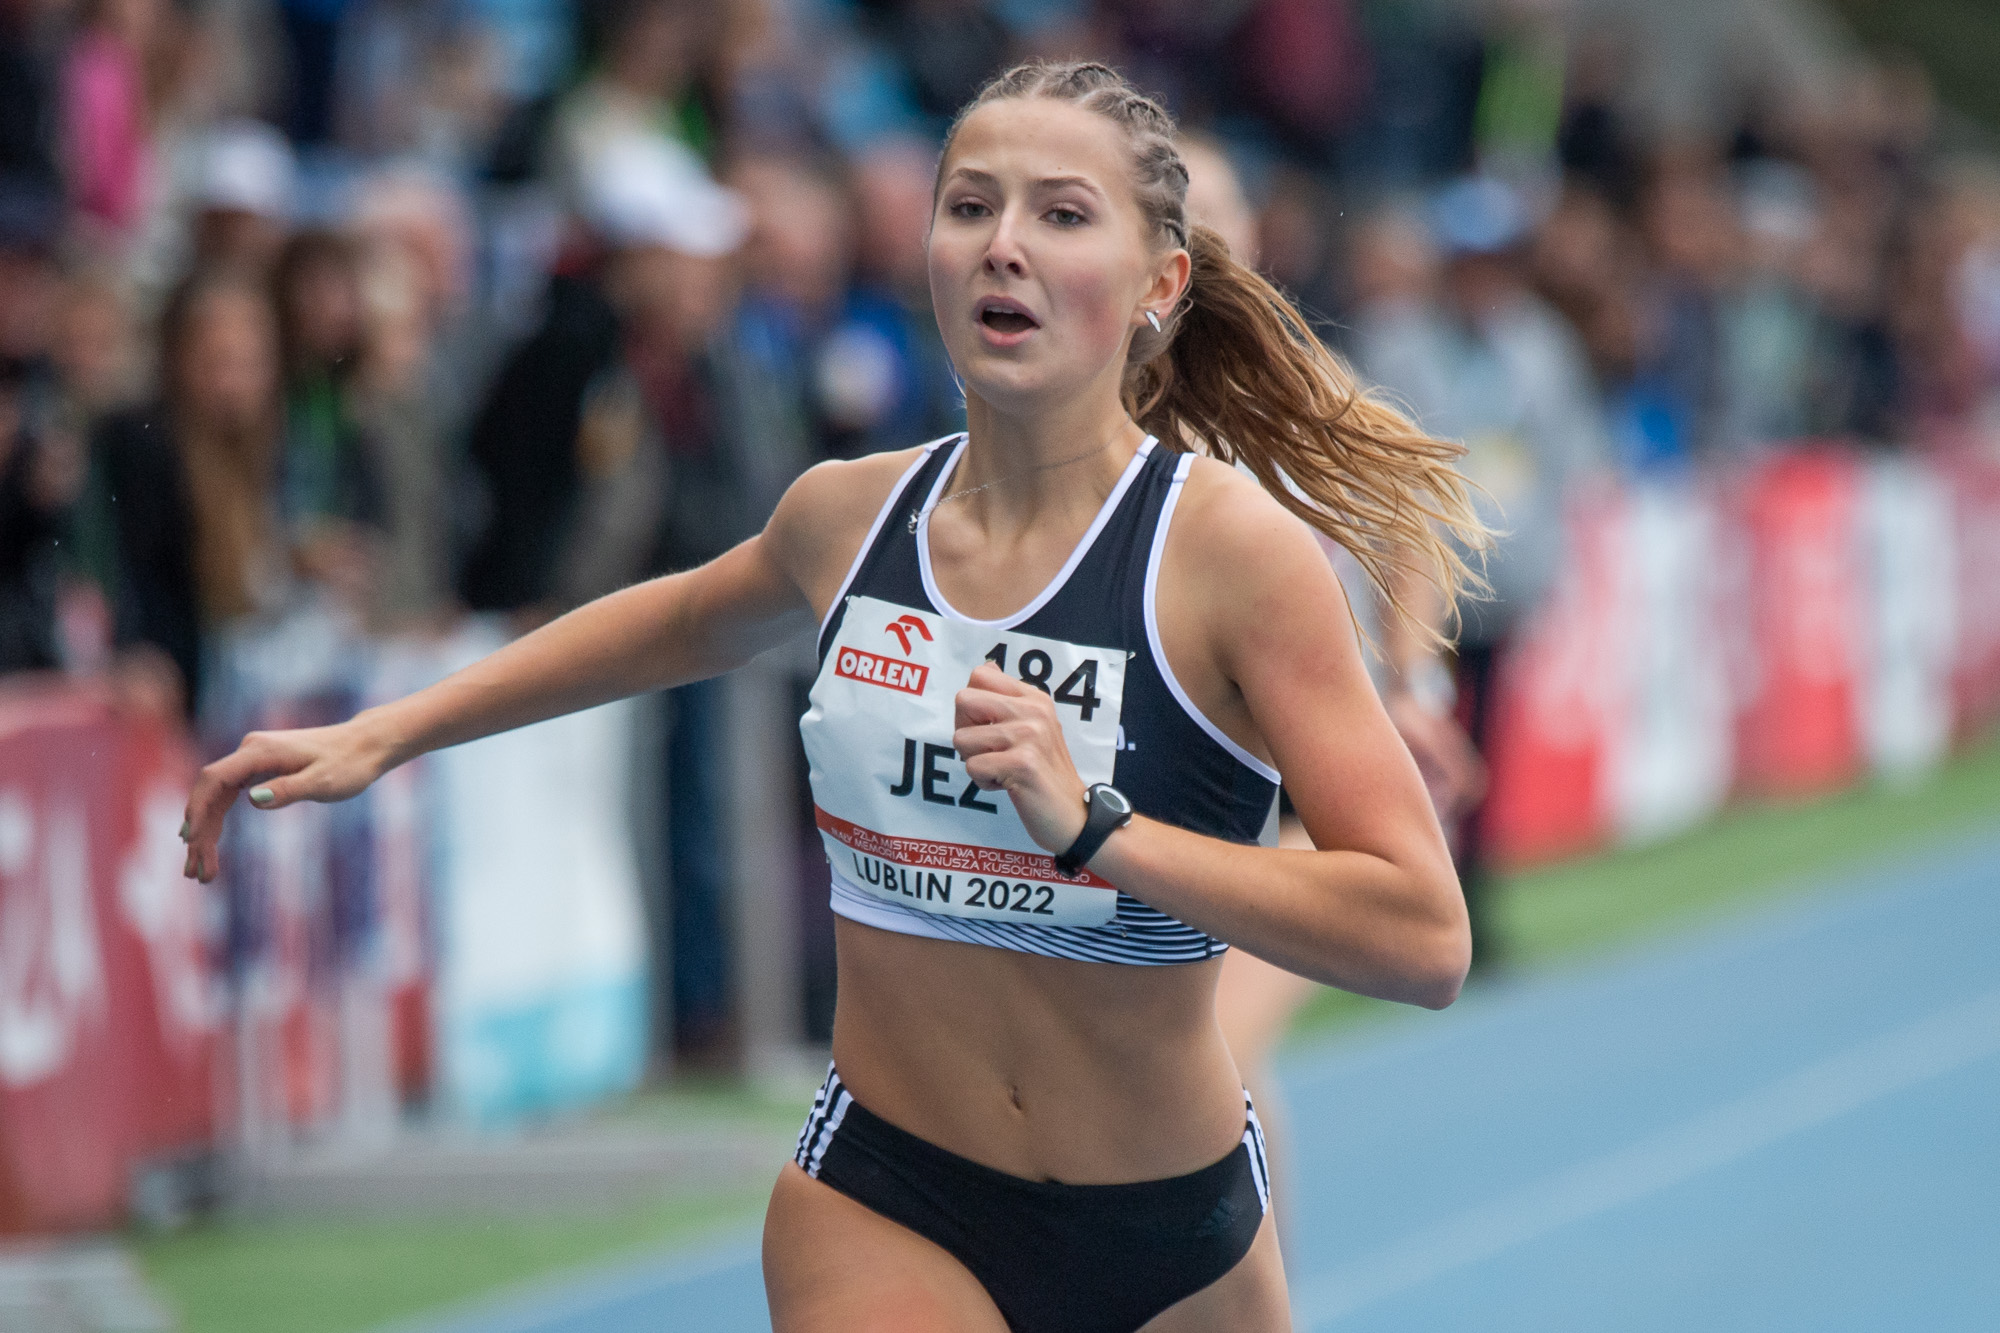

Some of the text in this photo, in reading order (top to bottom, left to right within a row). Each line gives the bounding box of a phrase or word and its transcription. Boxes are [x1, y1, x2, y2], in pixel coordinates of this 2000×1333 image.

[841, 652, 922, 691] ORLEN
[853, 827, 1052, 869] PZLA MISTRZOSTWA POLSKI U16
[854, 838, 912, 862] MEMORIAŁ
[915, 854, 980, 871] JANUSZA
[853, 852, 1055, 915] LUBLIN 2022
